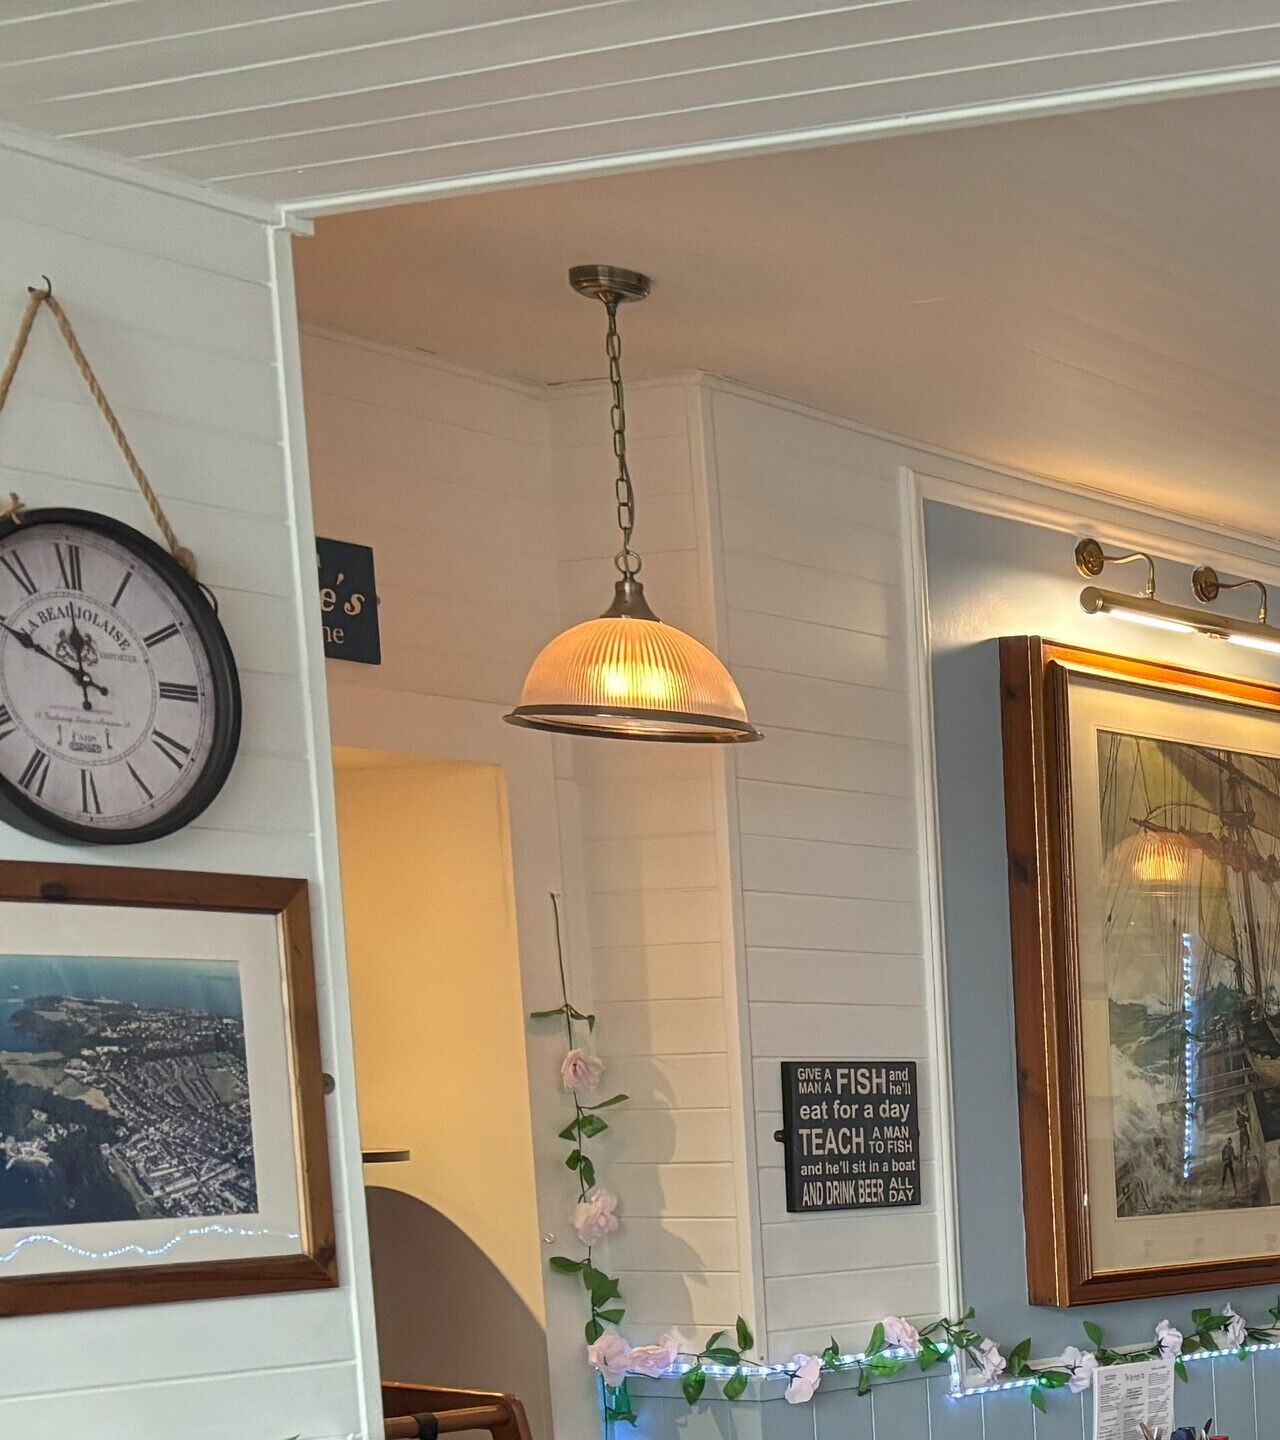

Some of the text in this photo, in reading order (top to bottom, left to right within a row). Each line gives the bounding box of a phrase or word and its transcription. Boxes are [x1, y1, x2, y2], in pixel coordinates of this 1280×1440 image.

[37, 605, 131, 651] BEAUJOLAISE
[797, 1068, 832, 1080] GIVE A
[889, 1068, 909, 1081] and
[798, 1082, 832, 1094] MAN A
[836, 1068, 887, 1095] FISH
[889, 1082, 911, 1096] he'll
[800, 1099, 910, 1123] eat for a day
[872, 1126, 909, 1139] A MAN
[798, 1127, 864, 1156] TEACH
[868, 1140, 913, 1154] TO FISH
[800, 1158, 916, 1176] and he'll sit in a boat
[889, 1177, 913, 1189] ALL
[802, 1178, 884, 1206] AND DRINK BEER
[889, 1189, 914, 1202] DAY
